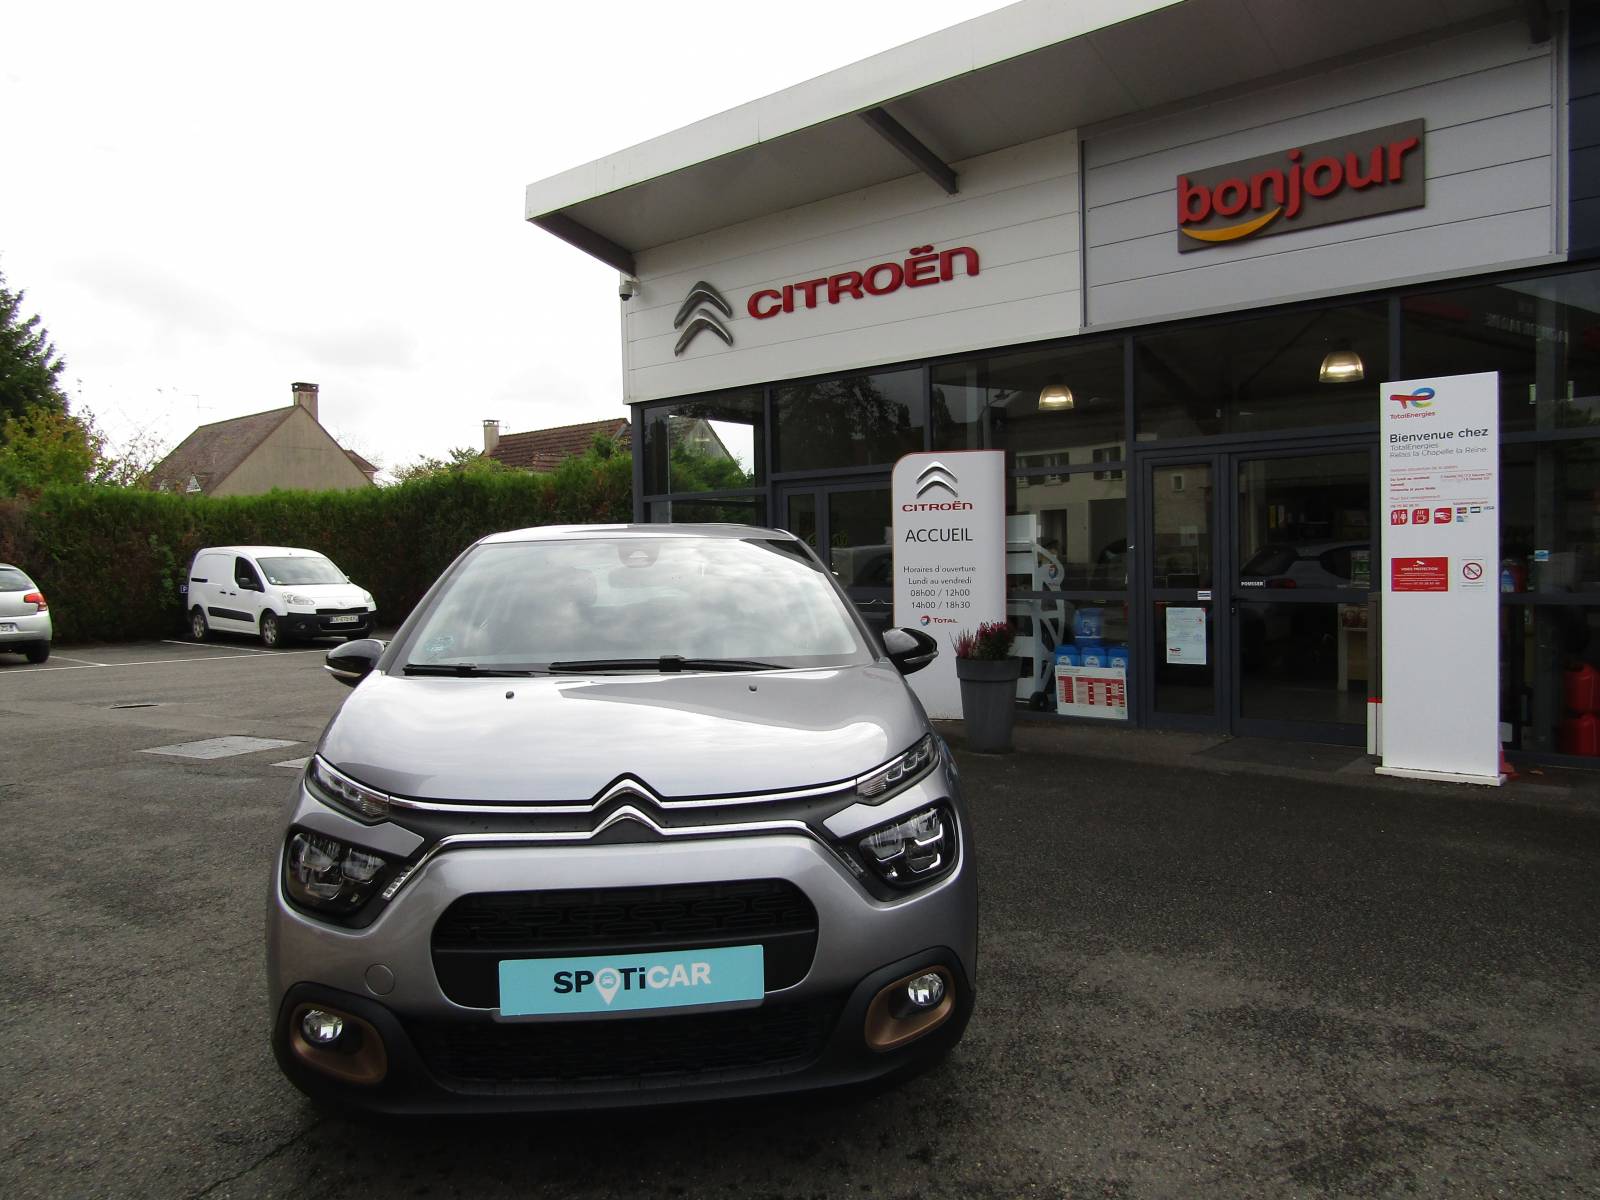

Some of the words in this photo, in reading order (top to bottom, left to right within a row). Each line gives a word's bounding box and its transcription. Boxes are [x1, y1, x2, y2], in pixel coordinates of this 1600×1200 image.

[1178, 136, 1419, 225] bonjour
[1390, 411, 1436, 420] TotalEnergies
[1390, 431, 1454, 443] Bienvenue
[1458, 428, 1489, 438] chez
[1391, 443, 1438, 452] TotalEnergies
[905, 528, 973, 543] ACCUEIL
[941, 577, 972, 585] vendredi
[910, 589, 936, 597] 08h00
[945, 589, 970, 597] 12h00
[912, 601, 936, 609] 14h00
[945, 601, 971, 609] 18h30
